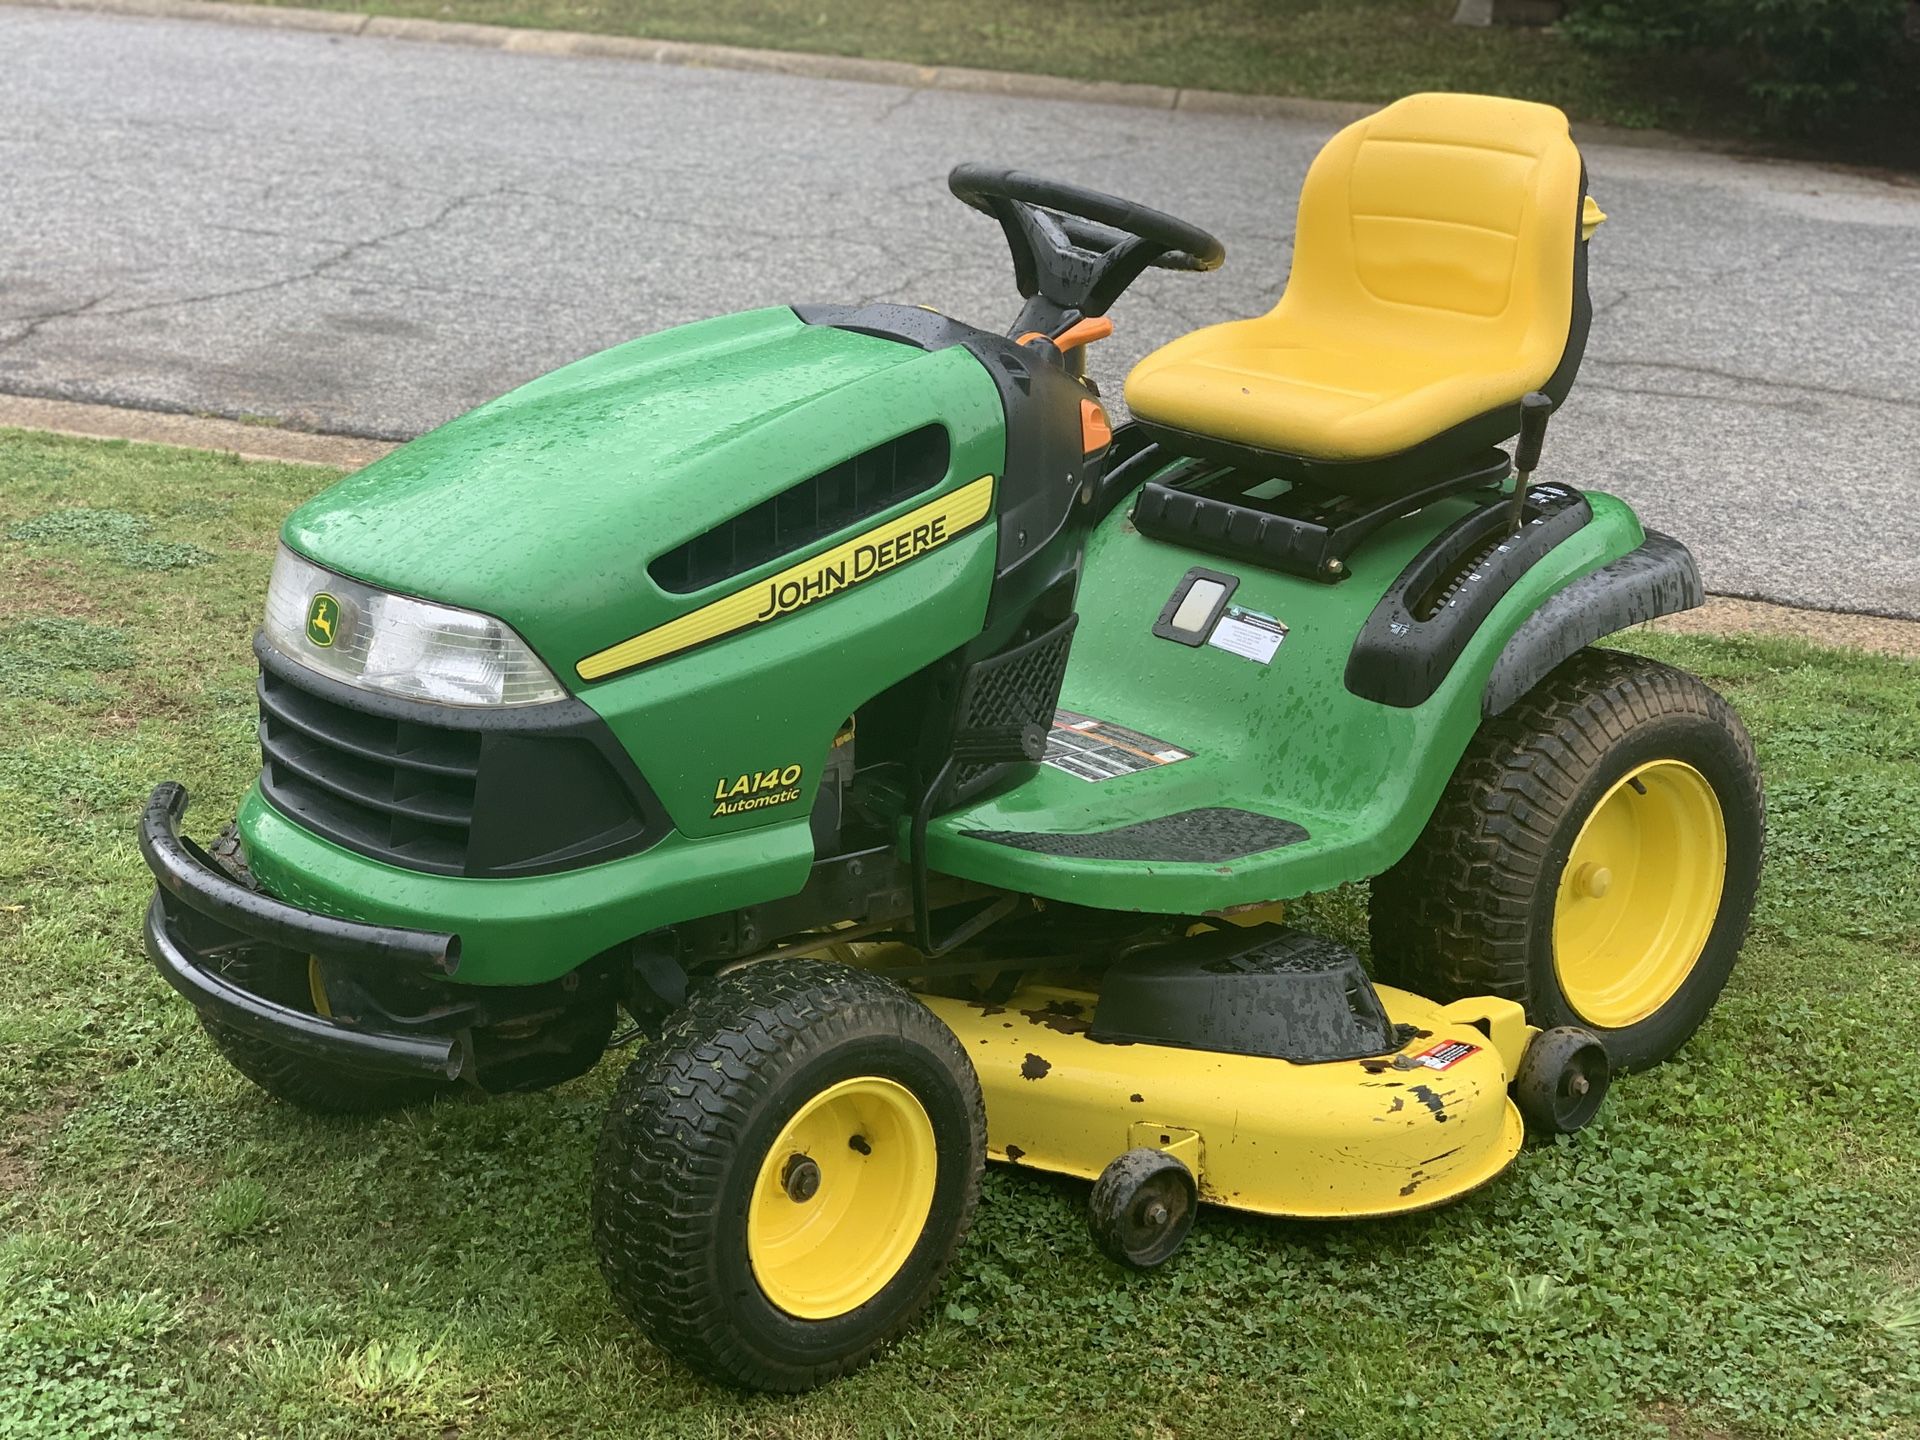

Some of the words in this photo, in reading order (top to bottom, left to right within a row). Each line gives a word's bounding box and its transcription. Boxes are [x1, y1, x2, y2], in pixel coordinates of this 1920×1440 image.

[758, 560, 846, 619] JOHN
[853, 514, 947, 579] DEERE
[1469, 573, 1482, 582] 2
[715, 763, 802, 800] LA140
[712, 787, 800, 817] Automatic
